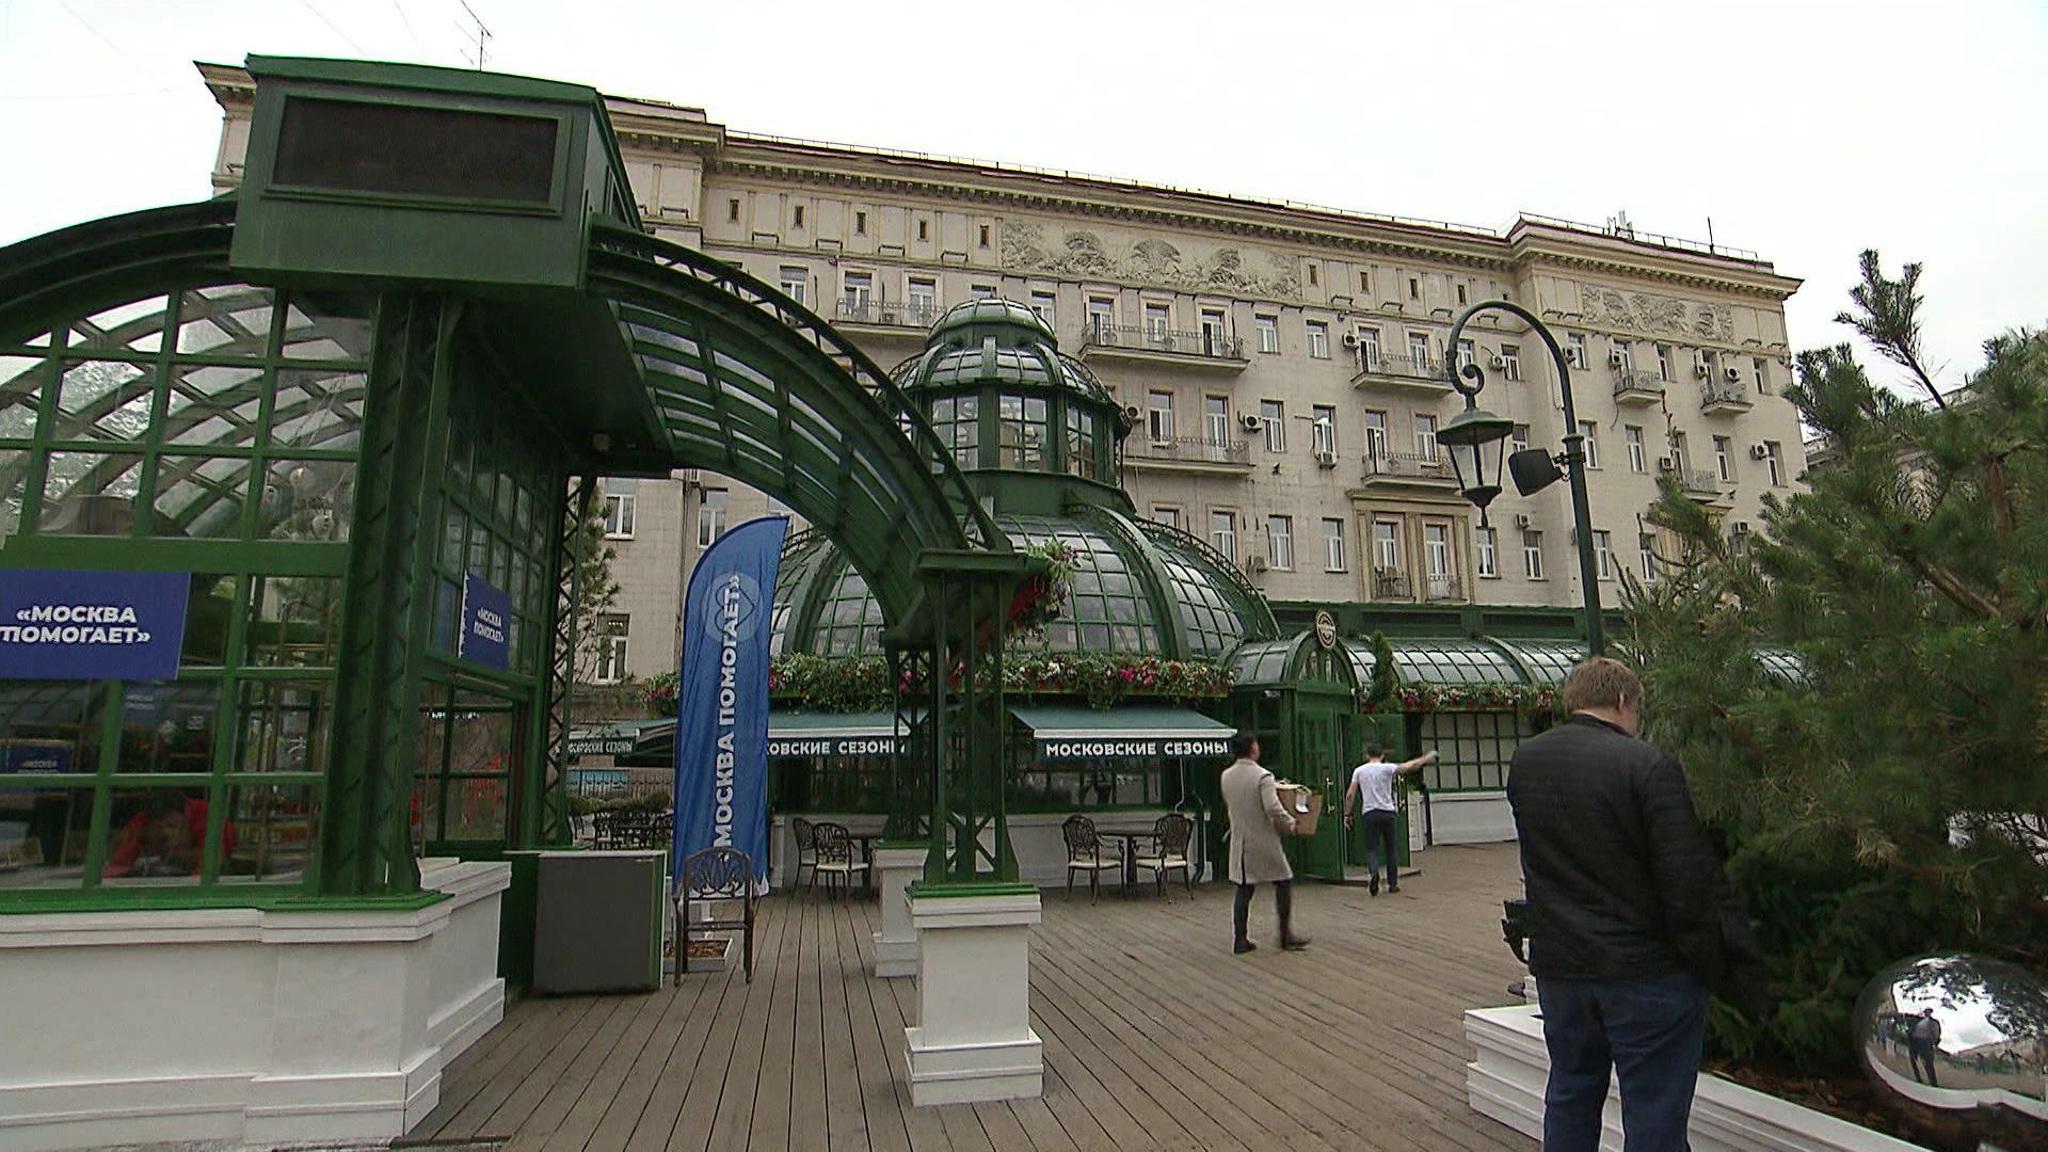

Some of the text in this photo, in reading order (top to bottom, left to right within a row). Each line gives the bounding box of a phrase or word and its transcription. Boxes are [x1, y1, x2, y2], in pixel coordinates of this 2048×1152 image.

[16, 605, 137, 624] «МОСКВА
[0, 626, 151, 644] ПОМОГАЕТ»
[767, 741, 831, 756] ОВСКИЕ
[1045, 741, 1228, 757] МОСКОВСКИЕ СЕЗОНЫ
